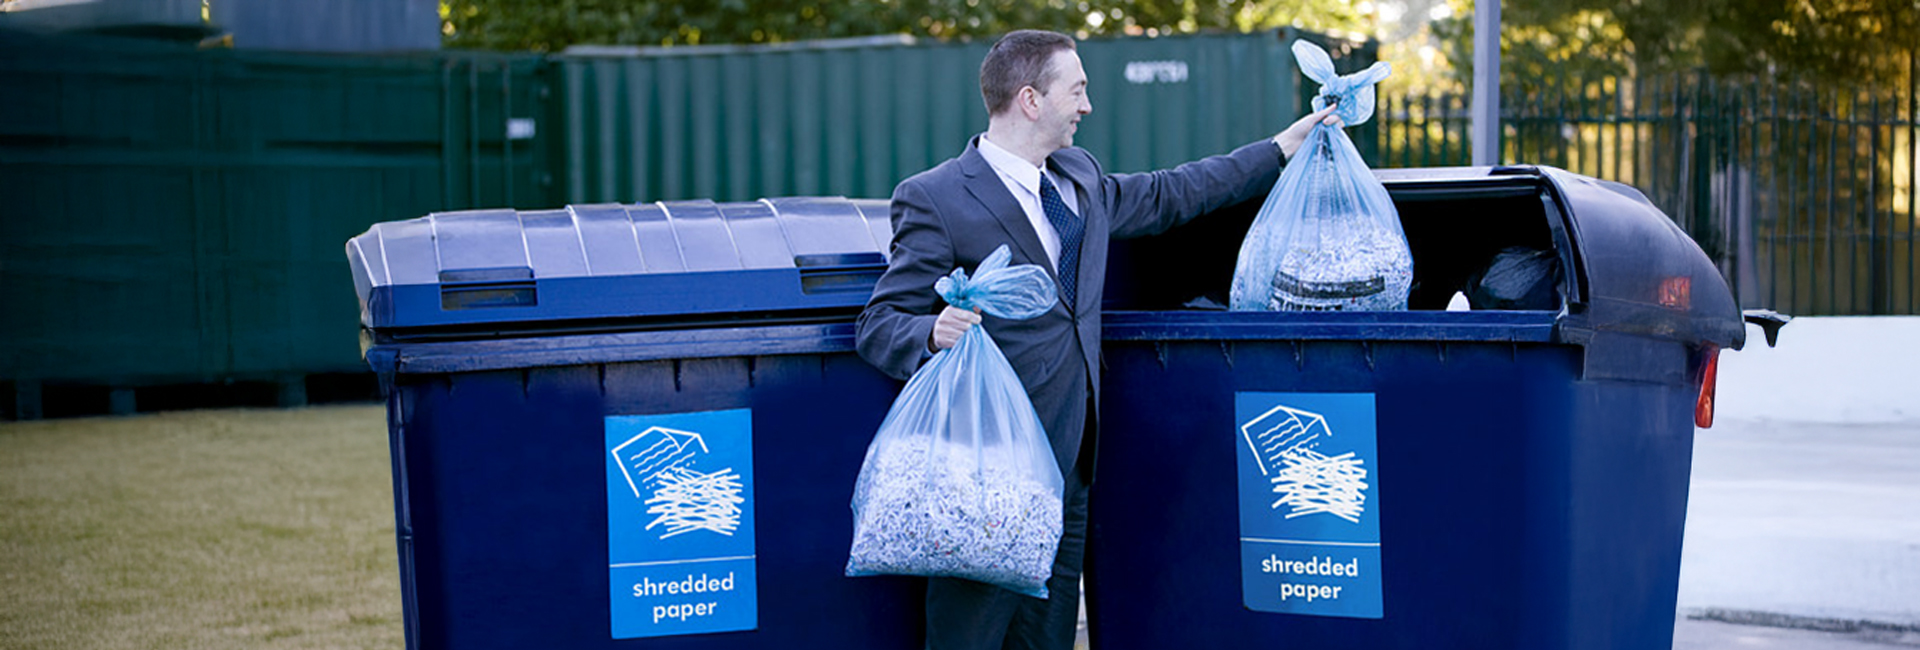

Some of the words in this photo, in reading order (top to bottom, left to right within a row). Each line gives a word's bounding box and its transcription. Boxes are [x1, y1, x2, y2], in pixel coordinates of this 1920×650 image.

[1261, 554, 1358, 577] shredded
[633, 572, 734, 597] shredded
[1281, 583, 1342, 602] paper
[653, 602, 717, 624] paper
